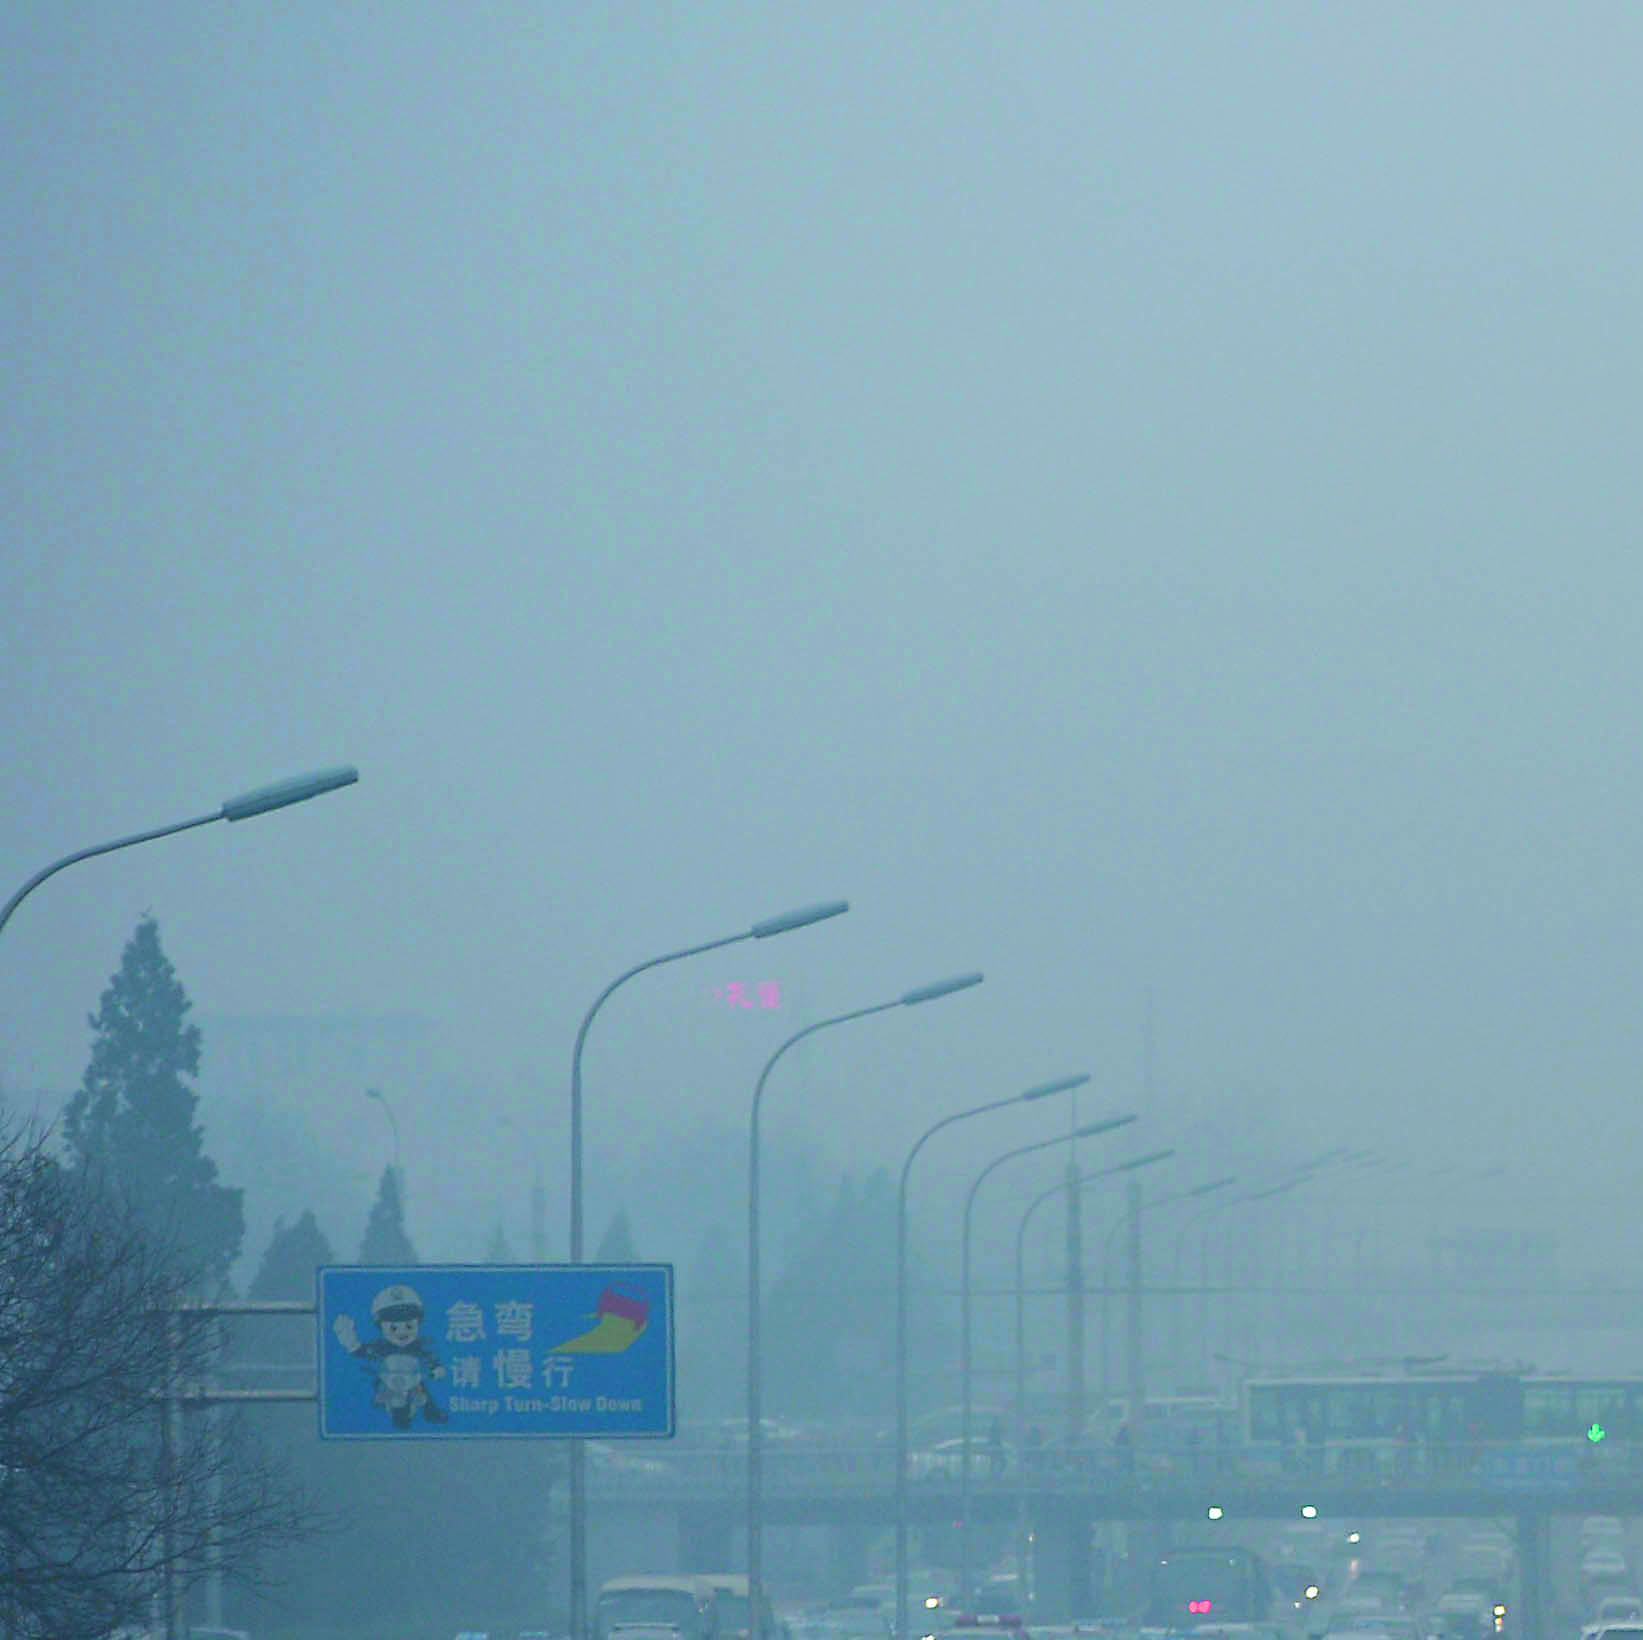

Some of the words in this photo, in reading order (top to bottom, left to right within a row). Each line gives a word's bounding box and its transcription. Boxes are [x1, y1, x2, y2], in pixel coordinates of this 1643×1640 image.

[446, 1300, 534, 1341] 急弯
[452, 1349, 575, 1388] 请慢行
[450, 1396, 498, 1413] Sharp
[596, 1396, 642, 1412] Down
